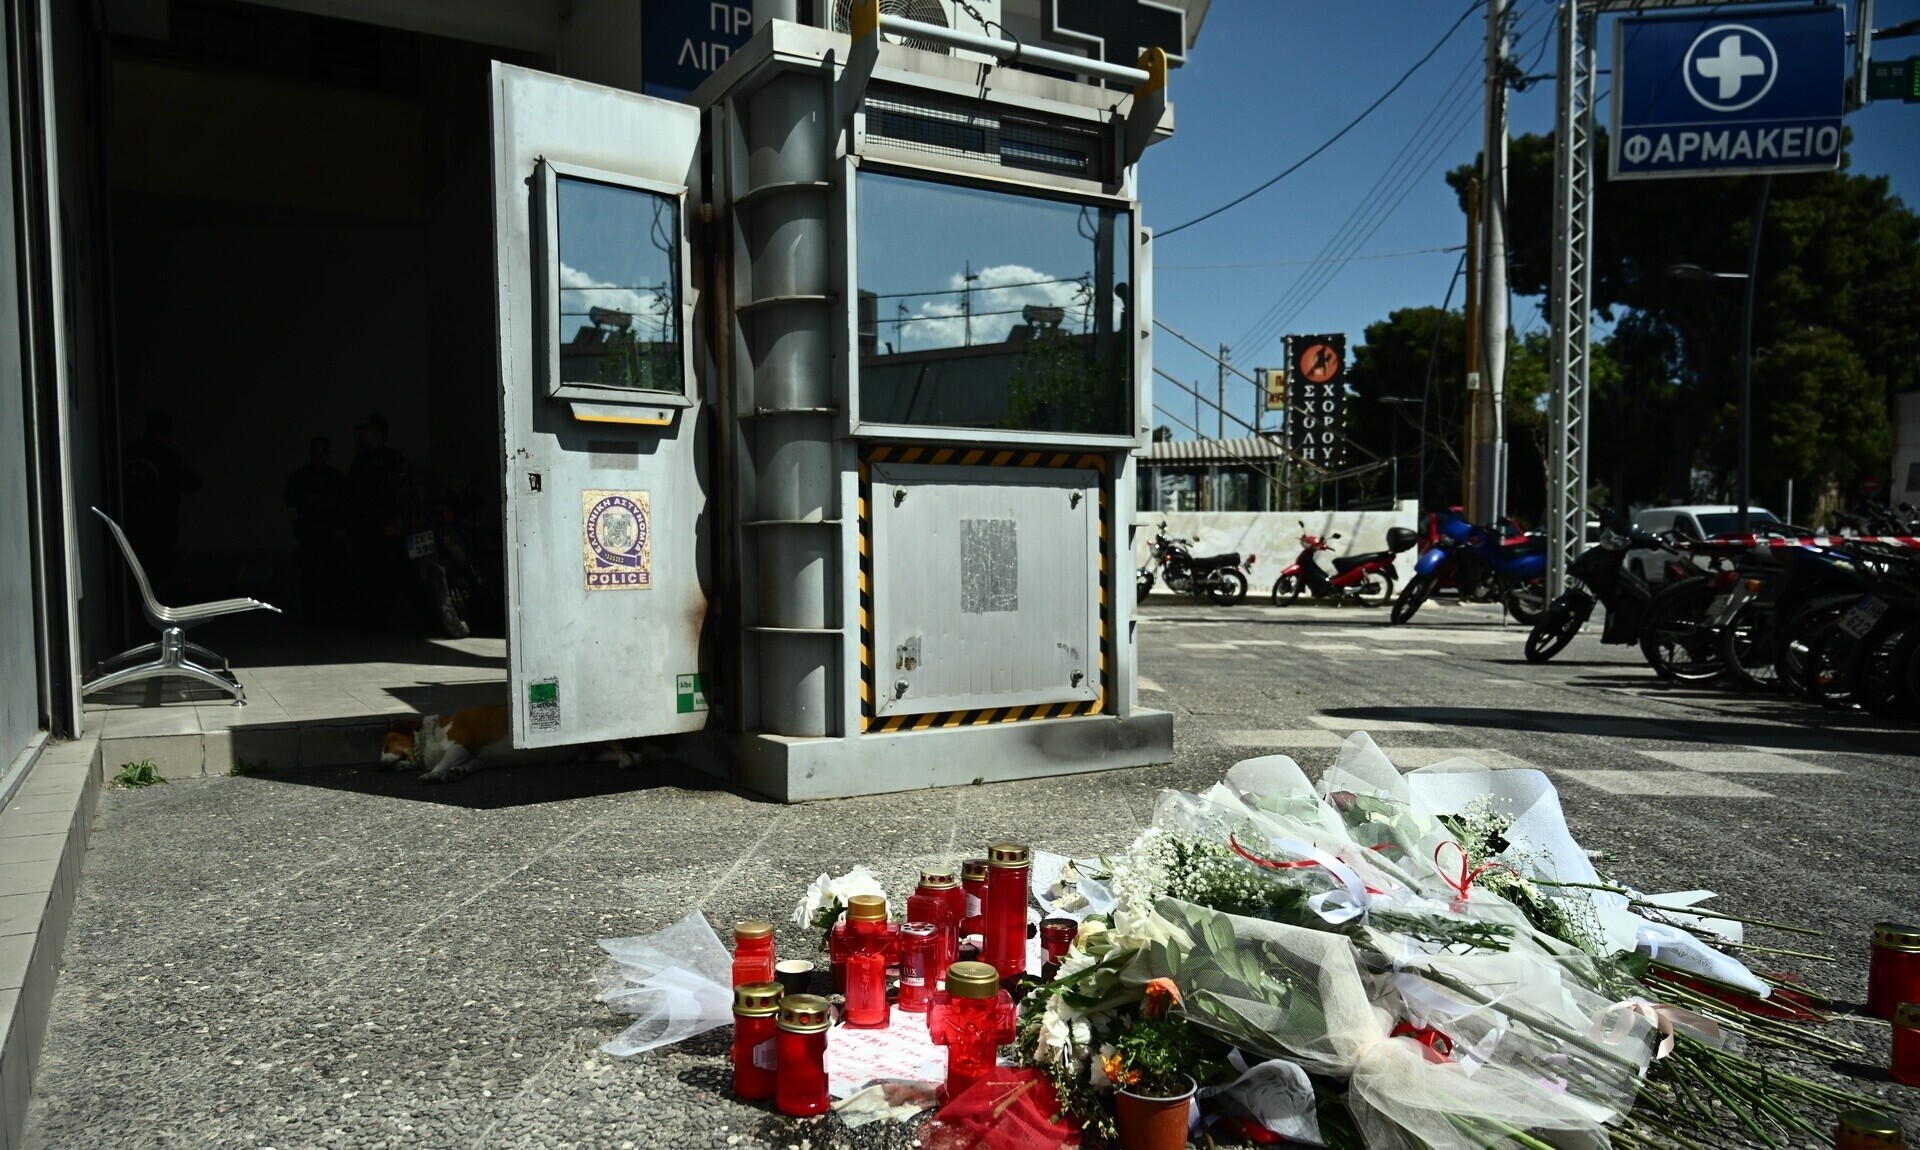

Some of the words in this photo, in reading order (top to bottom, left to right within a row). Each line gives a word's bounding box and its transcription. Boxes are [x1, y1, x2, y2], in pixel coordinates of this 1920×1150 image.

[1623, 126, 1839, 164] ΦΑΡΜΑΚΕΙΟ
[1303, 385, 1316, 460] ΣΧΟΛΗ
[1321, 384, 1335, 460] ΧΟΡΟΥ
[588, 499, 611, 554] ΕΛΛΗΝΙΚΗ
[614, 498, 646, 552] ΑΣΤΥΝΟΜΙΑ
[589, 573, 648, 584] POLICE
